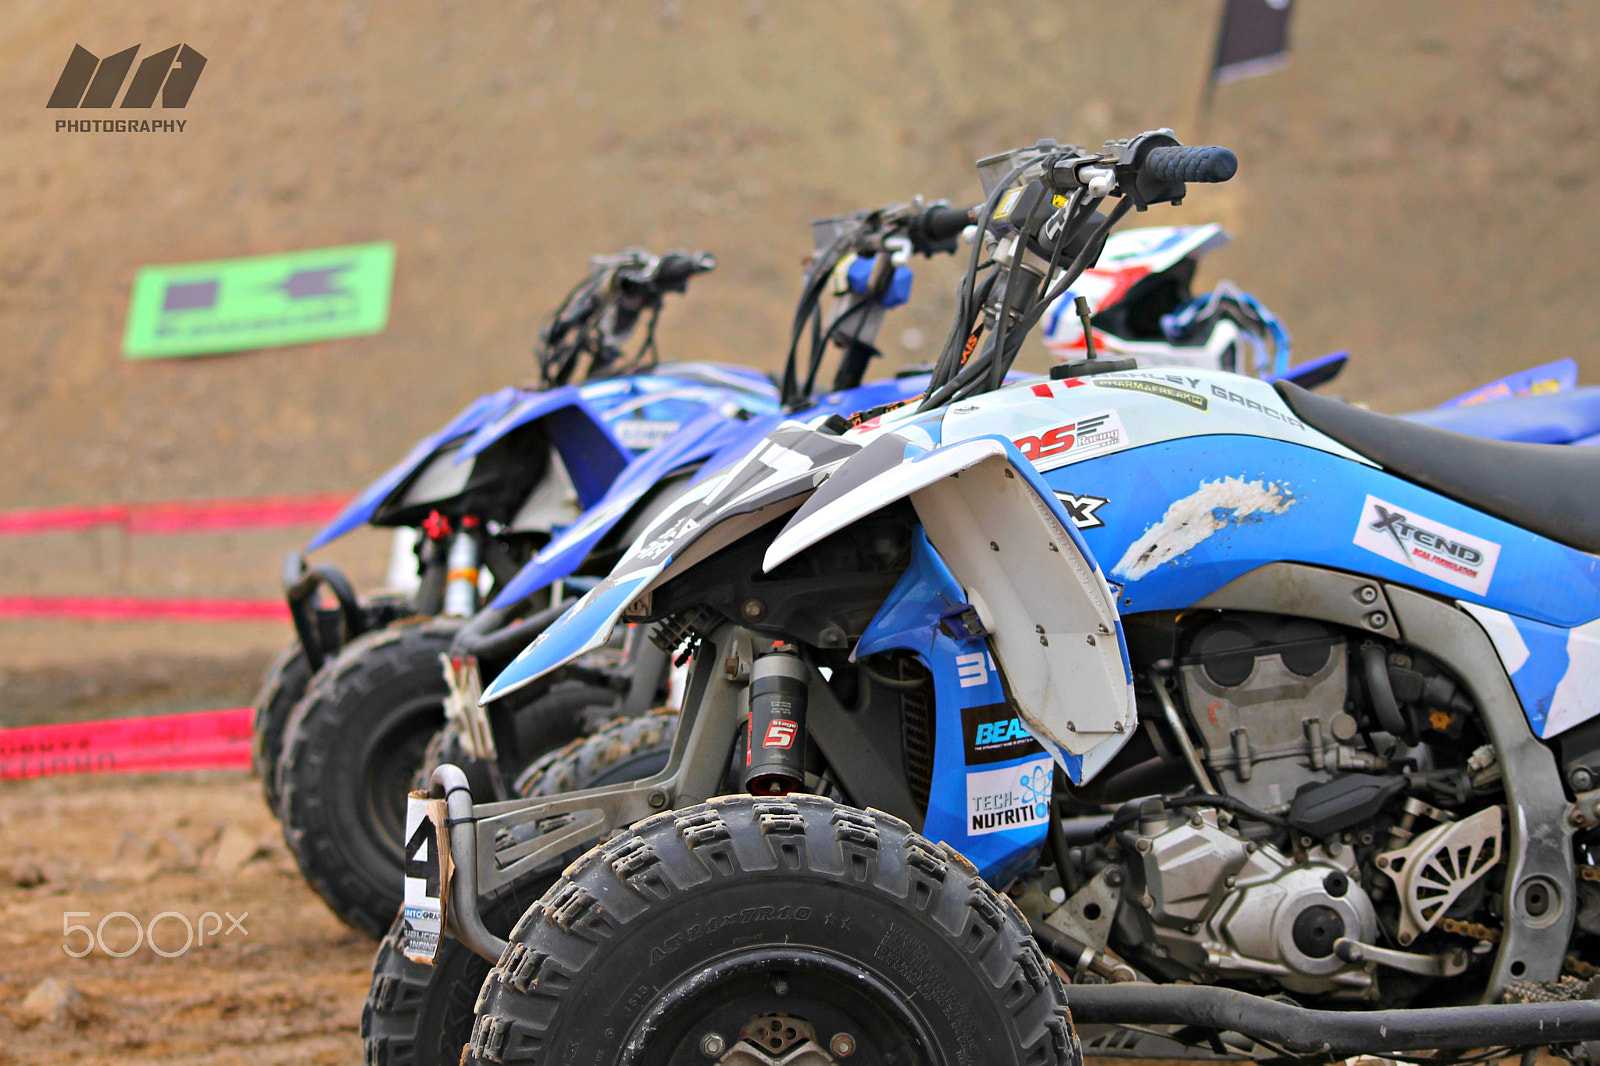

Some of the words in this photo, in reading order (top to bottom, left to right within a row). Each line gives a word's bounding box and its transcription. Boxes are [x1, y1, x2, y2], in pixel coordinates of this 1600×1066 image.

[1210, 384, 1306, 432] GARCIA
[1076, 429, 1119, 447] Racing
[1370, 504, 1483, 567] XTEND
[772, 720, 797, 729] Stage
[765, 726, 794, 747] 5
